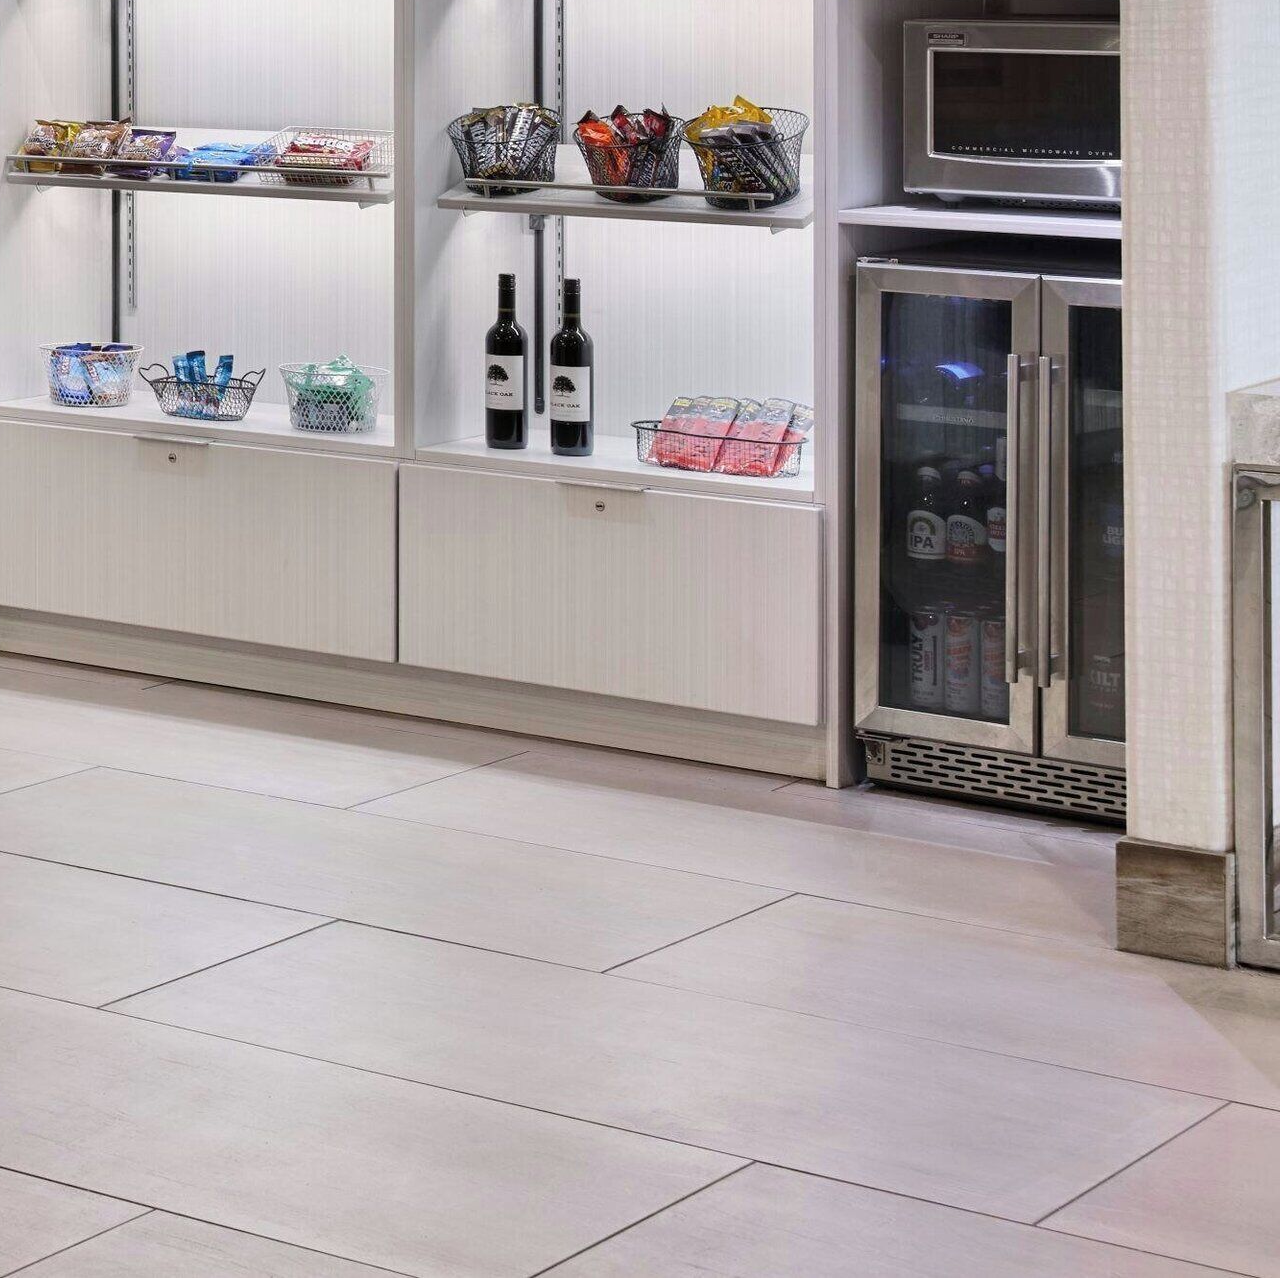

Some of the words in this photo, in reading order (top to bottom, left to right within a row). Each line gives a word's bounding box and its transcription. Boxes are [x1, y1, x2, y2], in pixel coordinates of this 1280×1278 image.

[951, 145, 1015, 153] COMMERCIAL
[1107, 526, 1123, 535] BU
[910, 534, 934, 549] IPA
[1103, 534, 1124, 545] LIG
[911, 633, 924, 683] TRULY
